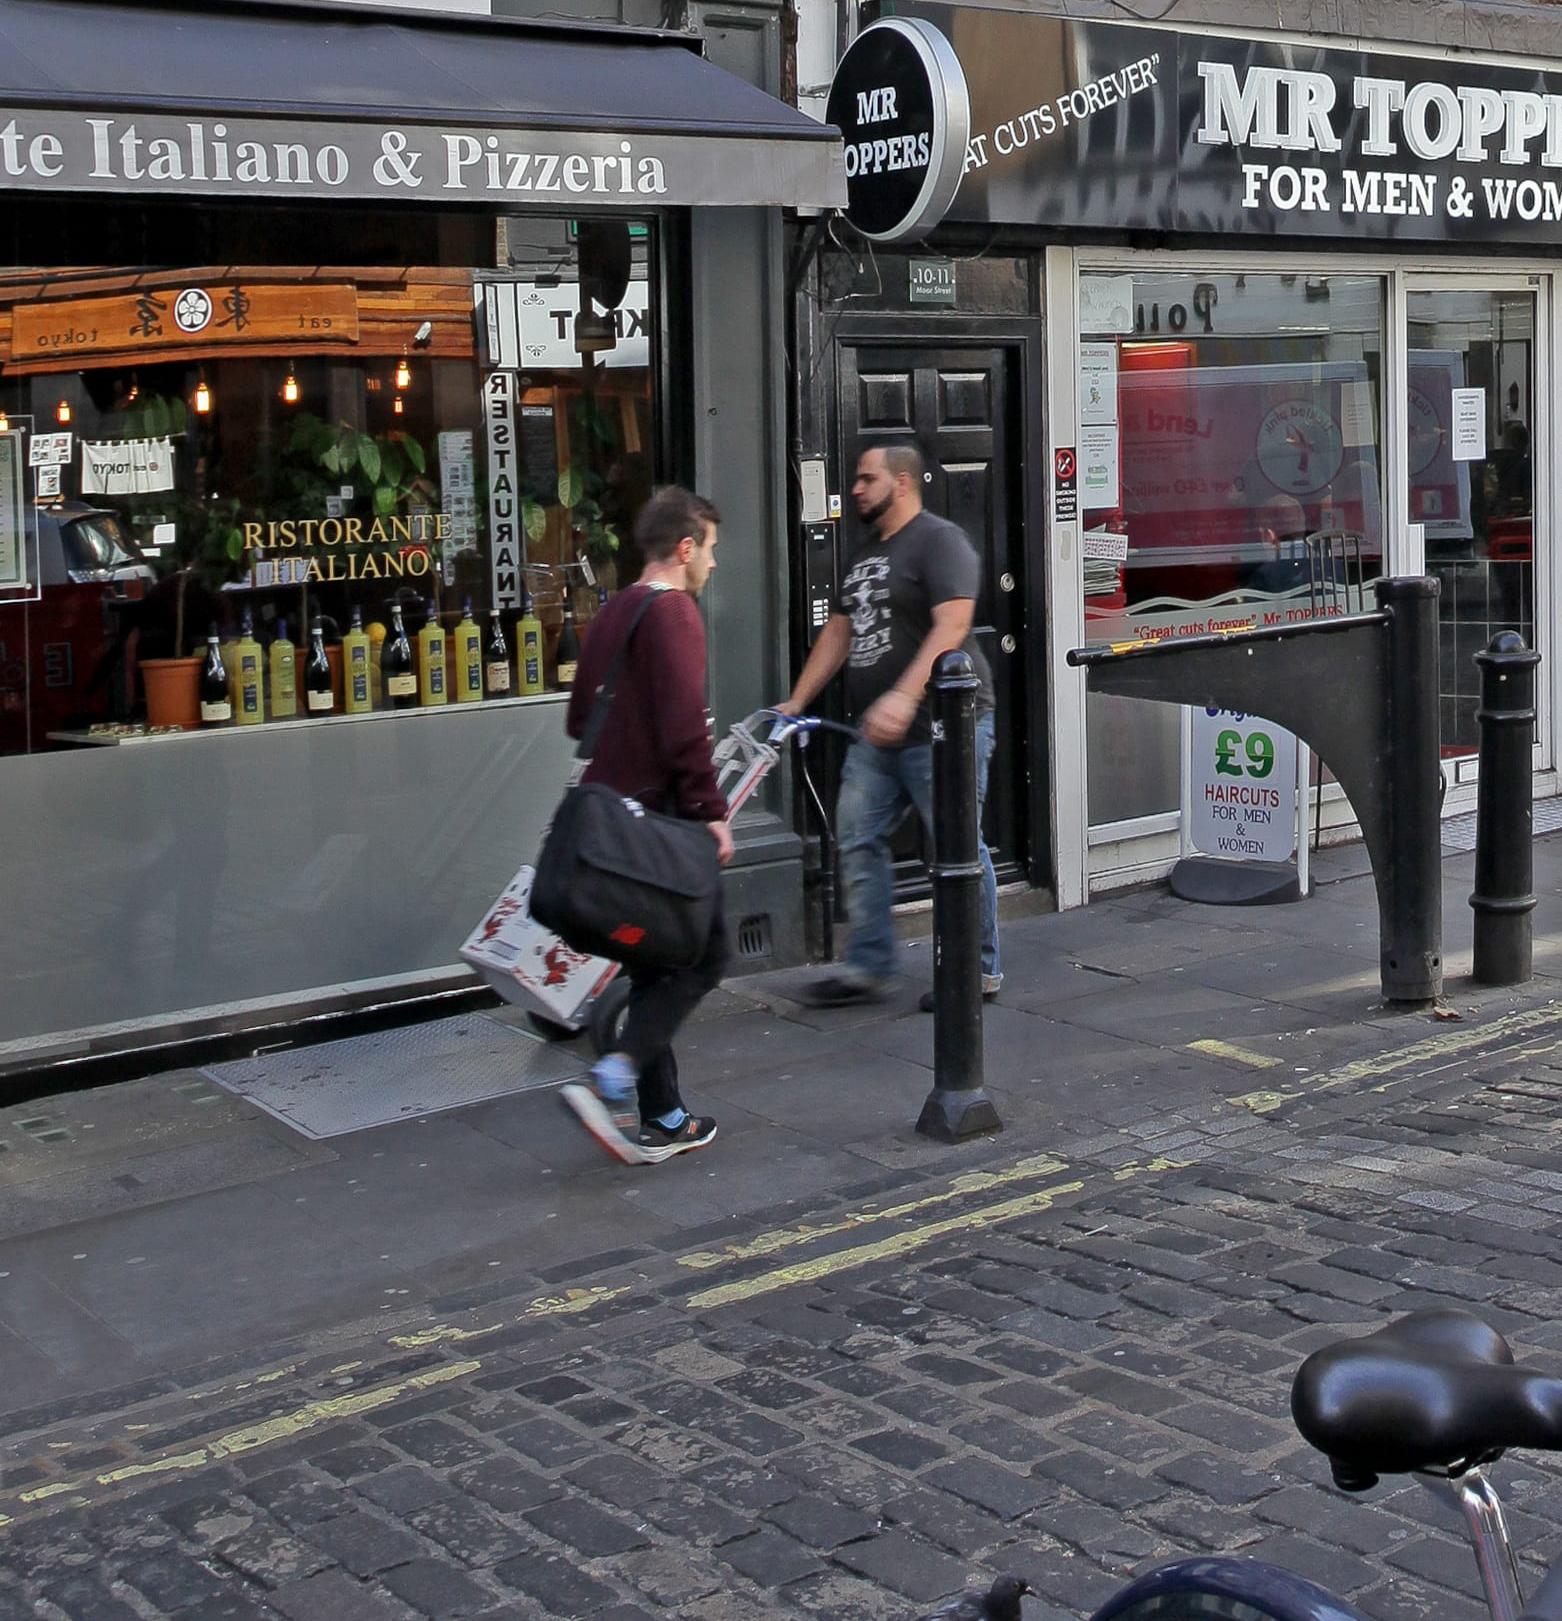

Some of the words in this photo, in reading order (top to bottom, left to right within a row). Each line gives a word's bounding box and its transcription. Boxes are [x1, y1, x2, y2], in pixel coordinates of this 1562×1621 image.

[856, 86, 898, 125] MR
[1196, 61, 1342, 153] MR
[994, 104, 1056, 155] CUTS
[85, 119, 349, 187] Italiano
[379, 130, 424, 187] &
[441, 133, 668, 195] Pizzeria
[844, 132, 930, 178] OPPERS
[1241, 164, 1330, 211] FOR
[1342, 169, 1438, 217] MEN
[1446, 175, 1474, 219] &
[916, 285, 932, 295] Moor
[933, 285, 951, 295] Street
[243, 513, 452, 550] RISTORANTE
[271, 549, 430, 585] ITALIANO
[1178, 622, 1204, 636] cuts
[1214, 729, 1275, 779] £9
[1204, 783, 1280, 808] HAIRCUTS
[1212, 805, 1237, 821] FOR
[1243, 809, 1271, 825] MEN
[1235, 822, 1246, 837] &
[1217, 837, 1265, 854] WOMEN
